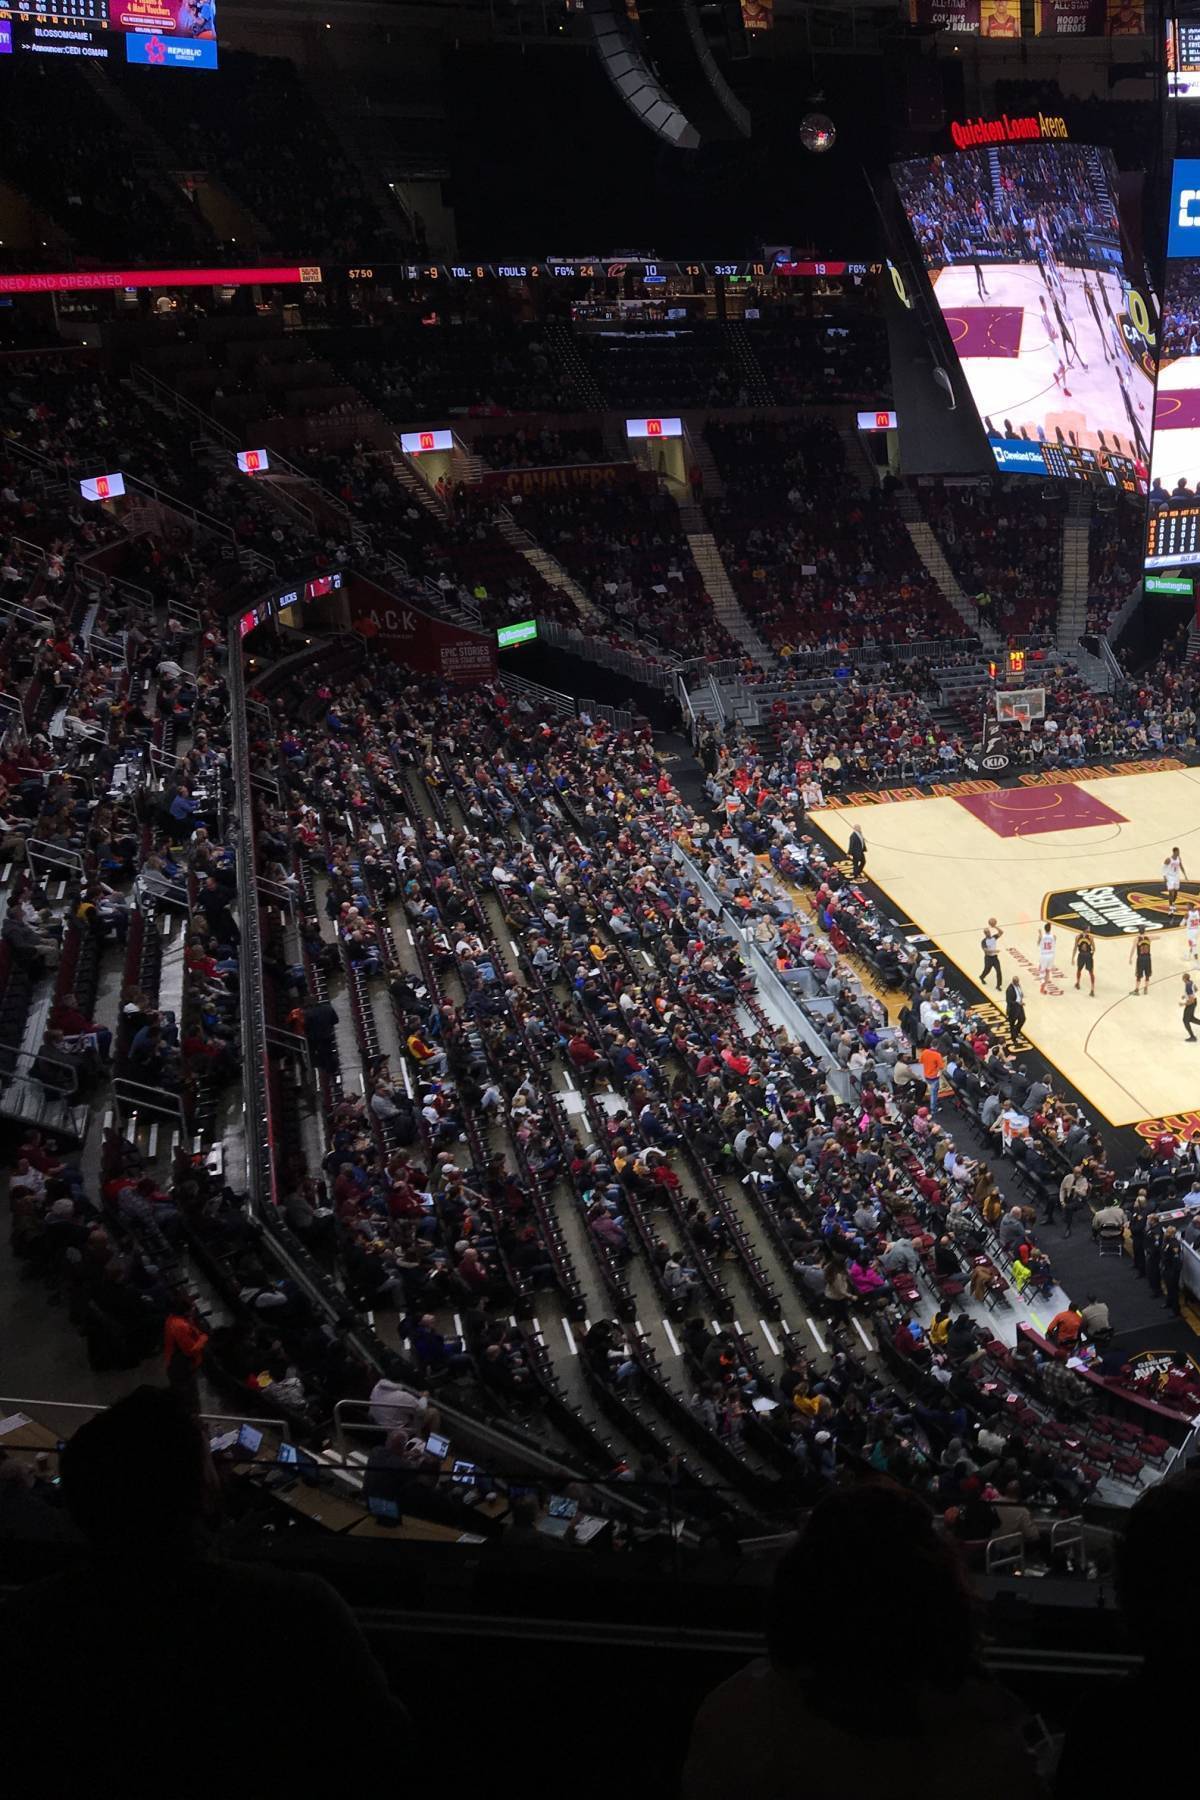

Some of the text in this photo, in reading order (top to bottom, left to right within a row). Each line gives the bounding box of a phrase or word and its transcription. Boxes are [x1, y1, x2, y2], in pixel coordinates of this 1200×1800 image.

[951, 111, 1069, 150] Quicken Loans Arena
[348, 269, 373, 279] $750
[423, 267, 438, 279] -9
[451, 266, 484, 278] TOL: 6
[498, 266, 539, 277] FOULS 2
[555, 266, 594, 277] FG% 24
[645, 265, 657, 276] 10
[686, 266, 699, 276] 13
[714, 265, 737, 275] 3:37
[753, 265, 765, 276] 1Q
[814, 263, 826, 274] 19
[848, 263, 883, 274] FG% 47
[29, 277, 56, 290] AND
[60, 274, 123, 288] OPERATED
[1154, 580, 1191, 592] Huntington
[459, 645, 490, 657] STORIES
[986, 756, 1005, 768] KIA
[811, 758, 1188, 812] CLEVELAND CAVALIERS
[1075, 886, 1164, 934] CAVALIERS
